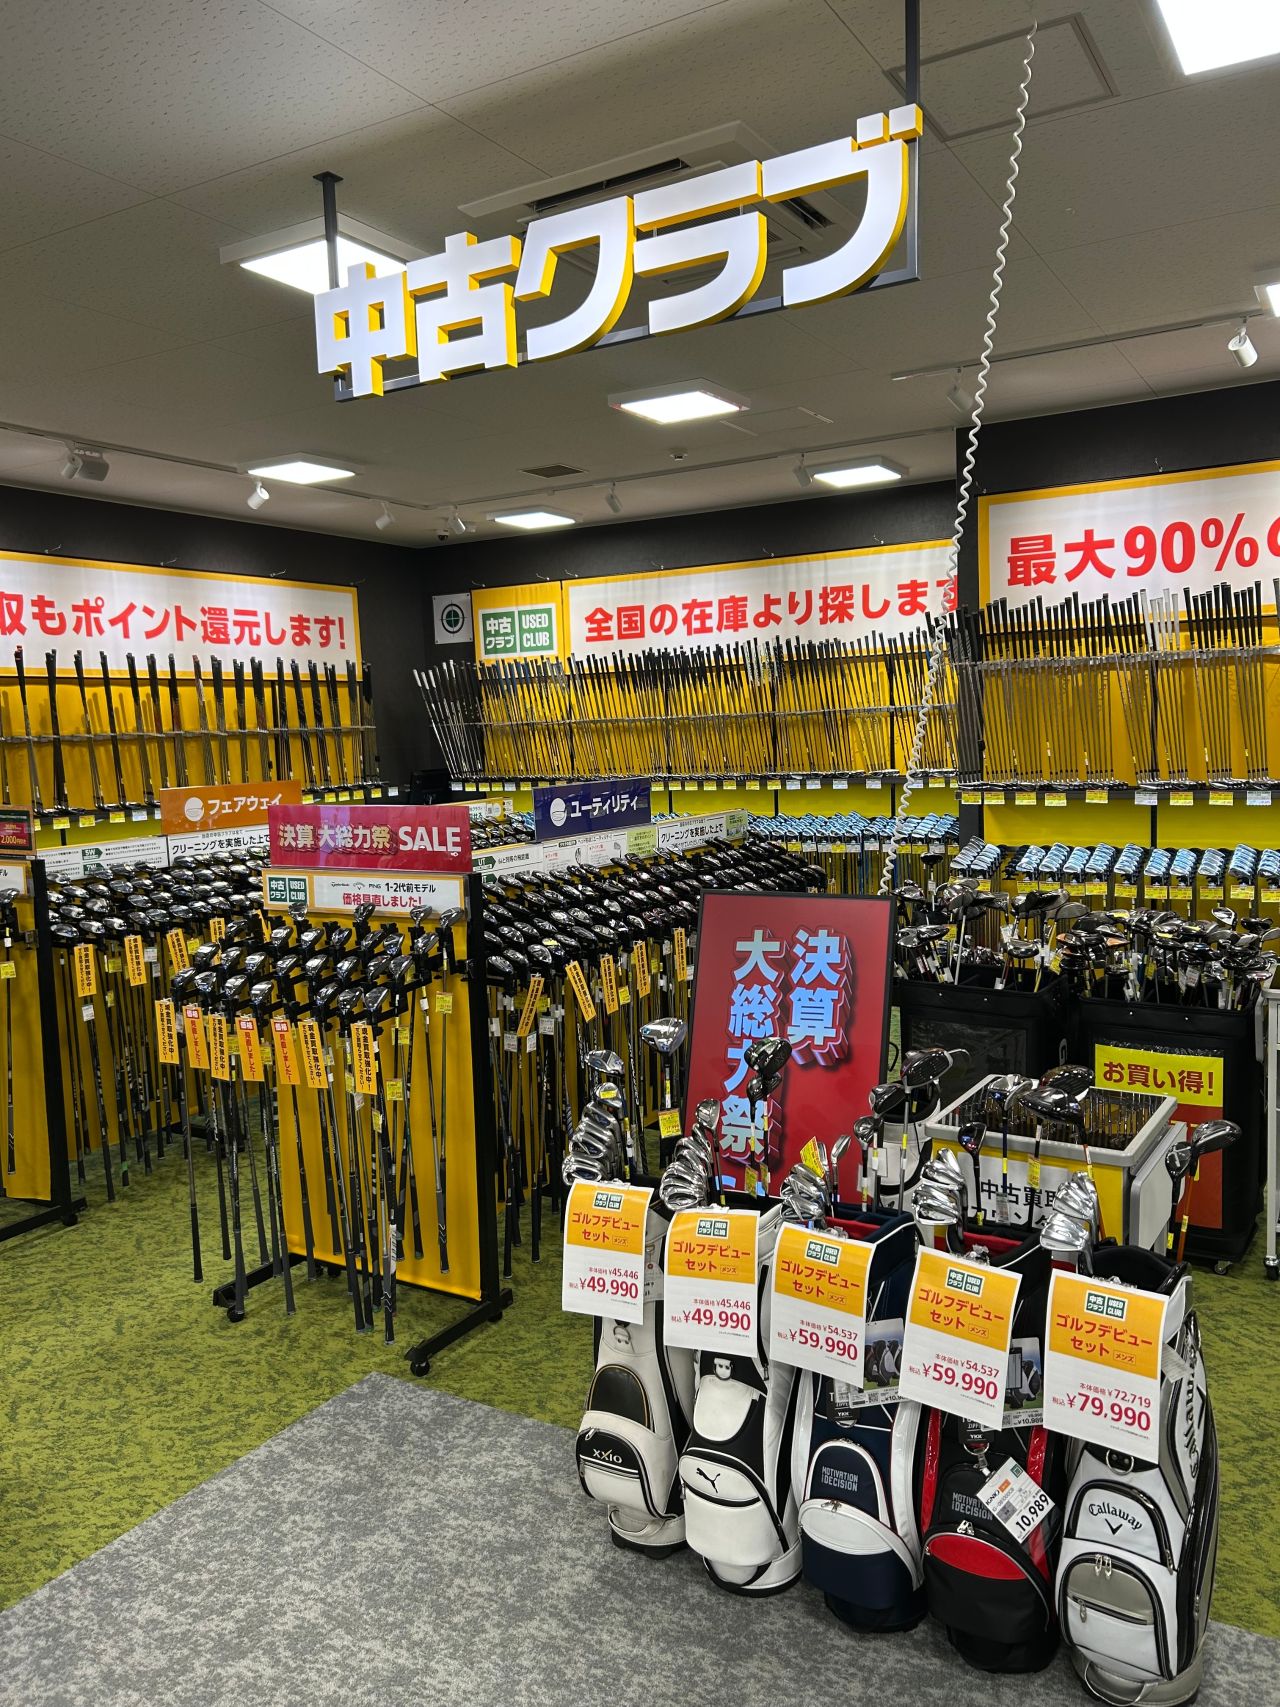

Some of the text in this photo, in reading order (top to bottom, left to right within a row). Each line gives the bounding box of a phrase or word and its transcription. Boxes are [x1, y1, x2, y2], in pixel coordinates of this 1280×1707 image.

[315, 104, 923, 397] 中古クラブ
[486, 617, 512, 634] 中古
[522, 613, 549, 629] USED
[486, 635, 514, 649] クラブ
[523, 632, 549, 648] CLUB
[208, 793, 282, 815] フェアウェイ
[571, 794, 638, 818] ユーティリティ
[279, 824, 461, 852] 決算 大総力祭 SALE
[270, 881, 285, 890] 中古
[289, 881, 305, 890] USED
[270, 891, 287, 900] クラブ
[290, 891, 305, 901] CLUB
[786, 928, 841, 1045] 決算
[1103, 1061, 1214, 1096] お買い得!
[572, 1212, 640, 1231] ゴルフデビュー
[582, 1229, 610, 1244] セット
[673, 1241, 751, 1259] ゴルフデビュー
[685, 1258, 718, 1273] セット
[781, 1260, 861, 1290] ゴルフデビュー
[579, 1276, 639, 1299] ¥49,990
[792, 1280, 824, 1298] セット
[919, 1288, 1005, 1322] ゴルフデビュー
[1089, 1295, 1103, 1305] 中古
[1108, 1299, 1124, 1309] USED
[682, 1308, 751, 1331] ¥49,990
[1107, 1307, 1122, 1317] CLUB
[930, 1309, 987, 1336] セット メンズ
[1056, 1314, 1153, 1346] ゴルフデビュー
[789, 1328, 858, 1361] ¥59,990
[1070, 1337, 1135, 1363] セット メンズ
[922, 1363, 999, 1400] ¥59,990
[1066, 1392, 1151, 1431] ¥79,990
[593, 1448, 623, 1463] XXIO
[822, 1466, 858, 1482] MOTIVATION
[952, 1492, 987, 1509] MOTIVATI
[1016, 1494, 1049, 1532] 10,989
[1088, 1501, 1143, 1531] Callaway
